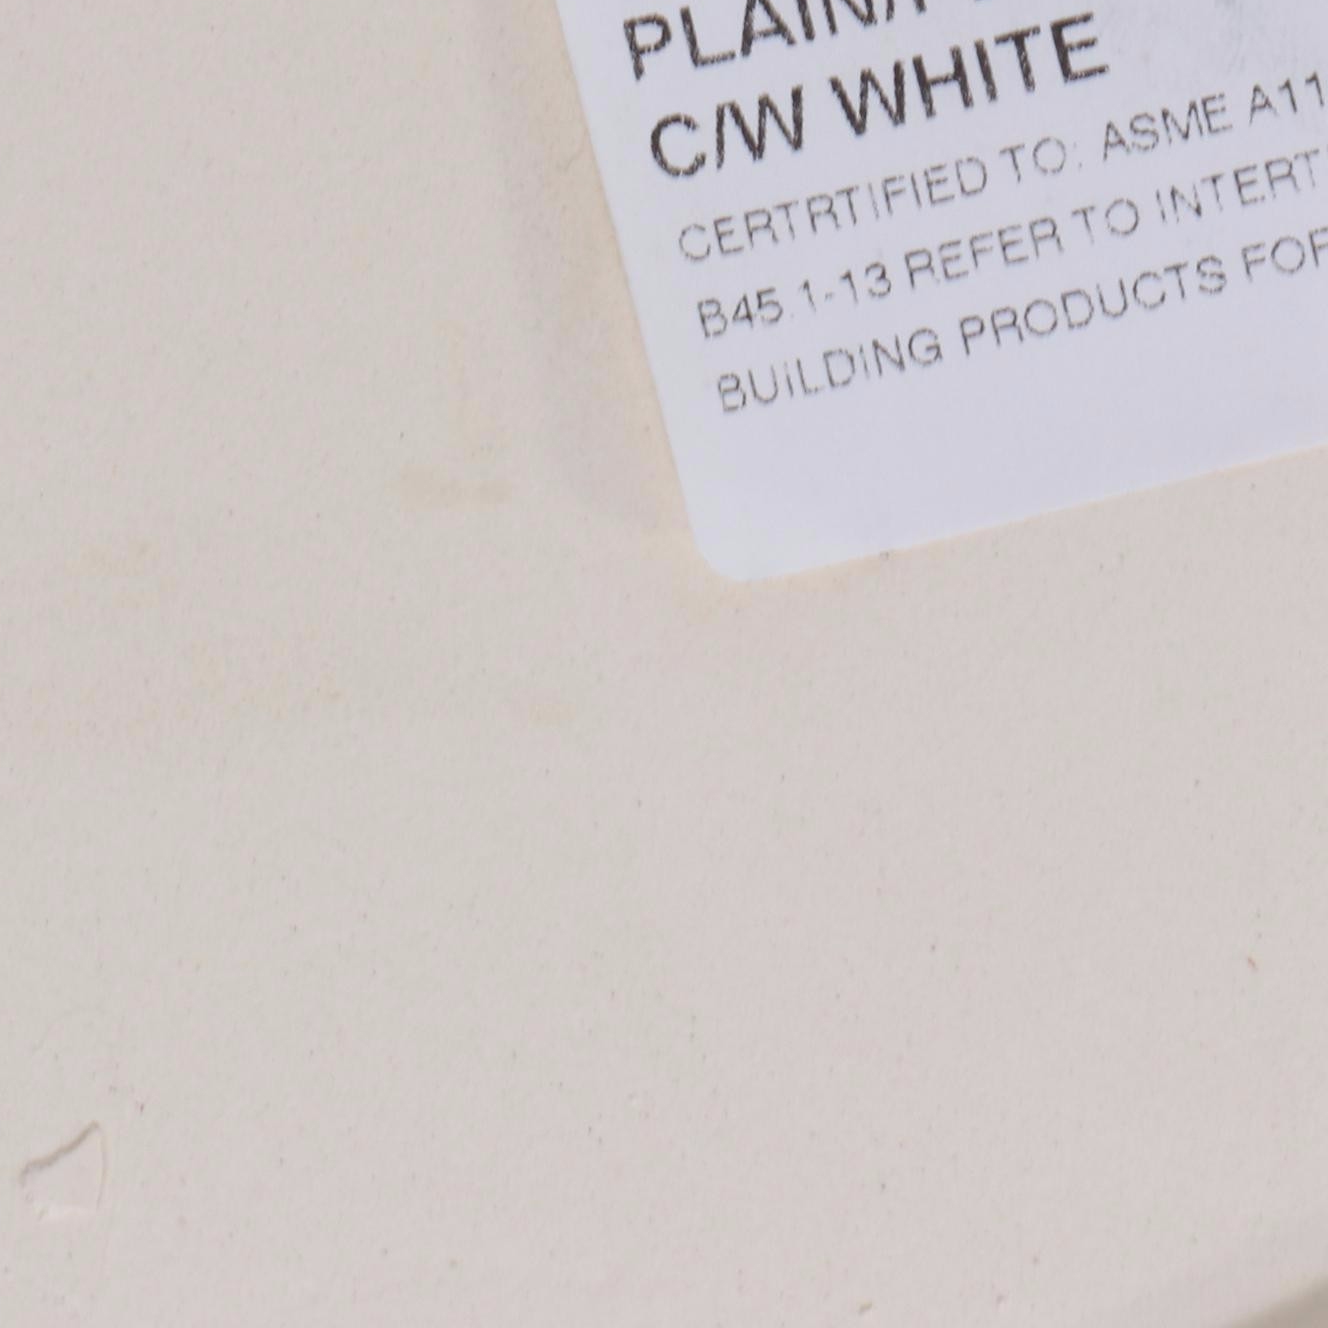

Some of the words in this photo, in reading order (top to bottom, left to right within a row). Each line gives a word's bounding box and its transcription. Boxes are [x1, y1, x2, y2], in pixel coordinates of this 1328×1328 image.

[649, 85, 805, 177] C/W
[829, 12, 1109, 136] WHITE
[678, 156, 987, 261] CERTRTIFIED
[1103, 93, 1233, 162] ASME
[905, 217, 1063, 288] REFER
[1072, 198, 1139, 242] TO
[718, 328, 942, 412] BUILDING
[959, 256, 1227, 356] PRODUCTS
